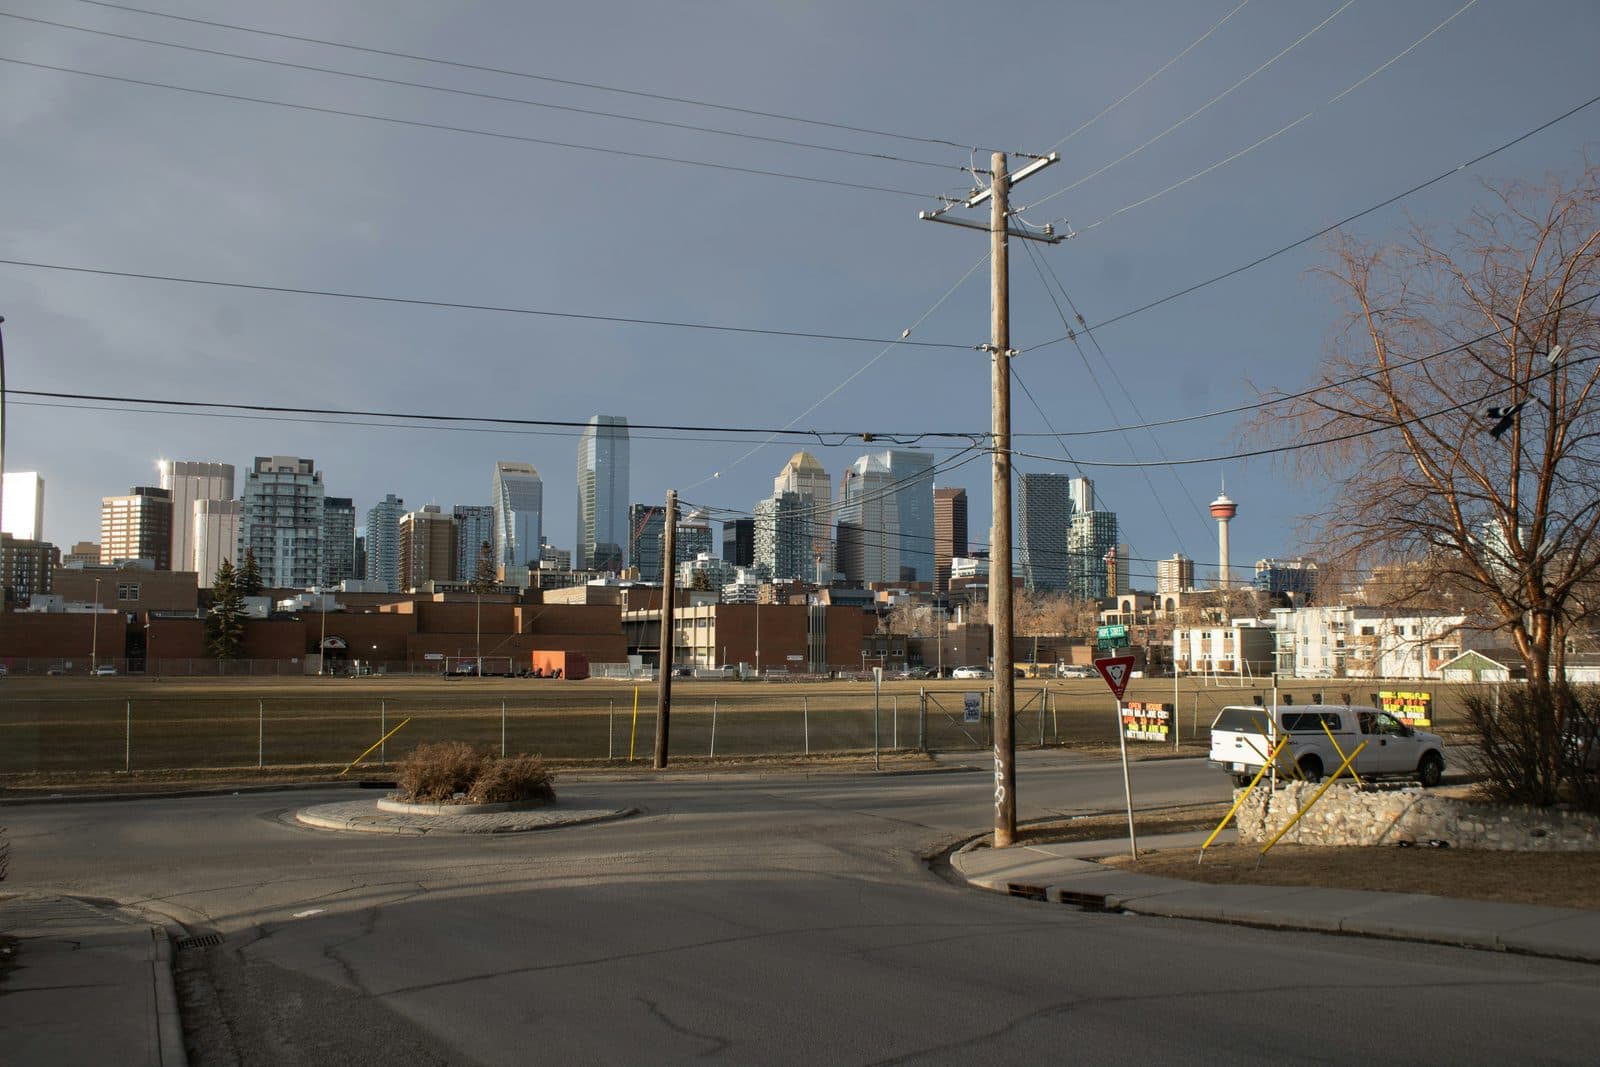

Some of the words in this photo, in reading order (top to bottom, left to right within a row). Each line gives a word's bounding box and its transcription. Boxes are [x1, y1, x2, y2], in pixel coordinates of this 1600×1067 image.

[1128, 702, 1141, 710] OPEN
[1146, 702, 1162, 711] HOUSE
[1147, 710, 1157, 718] JOE
